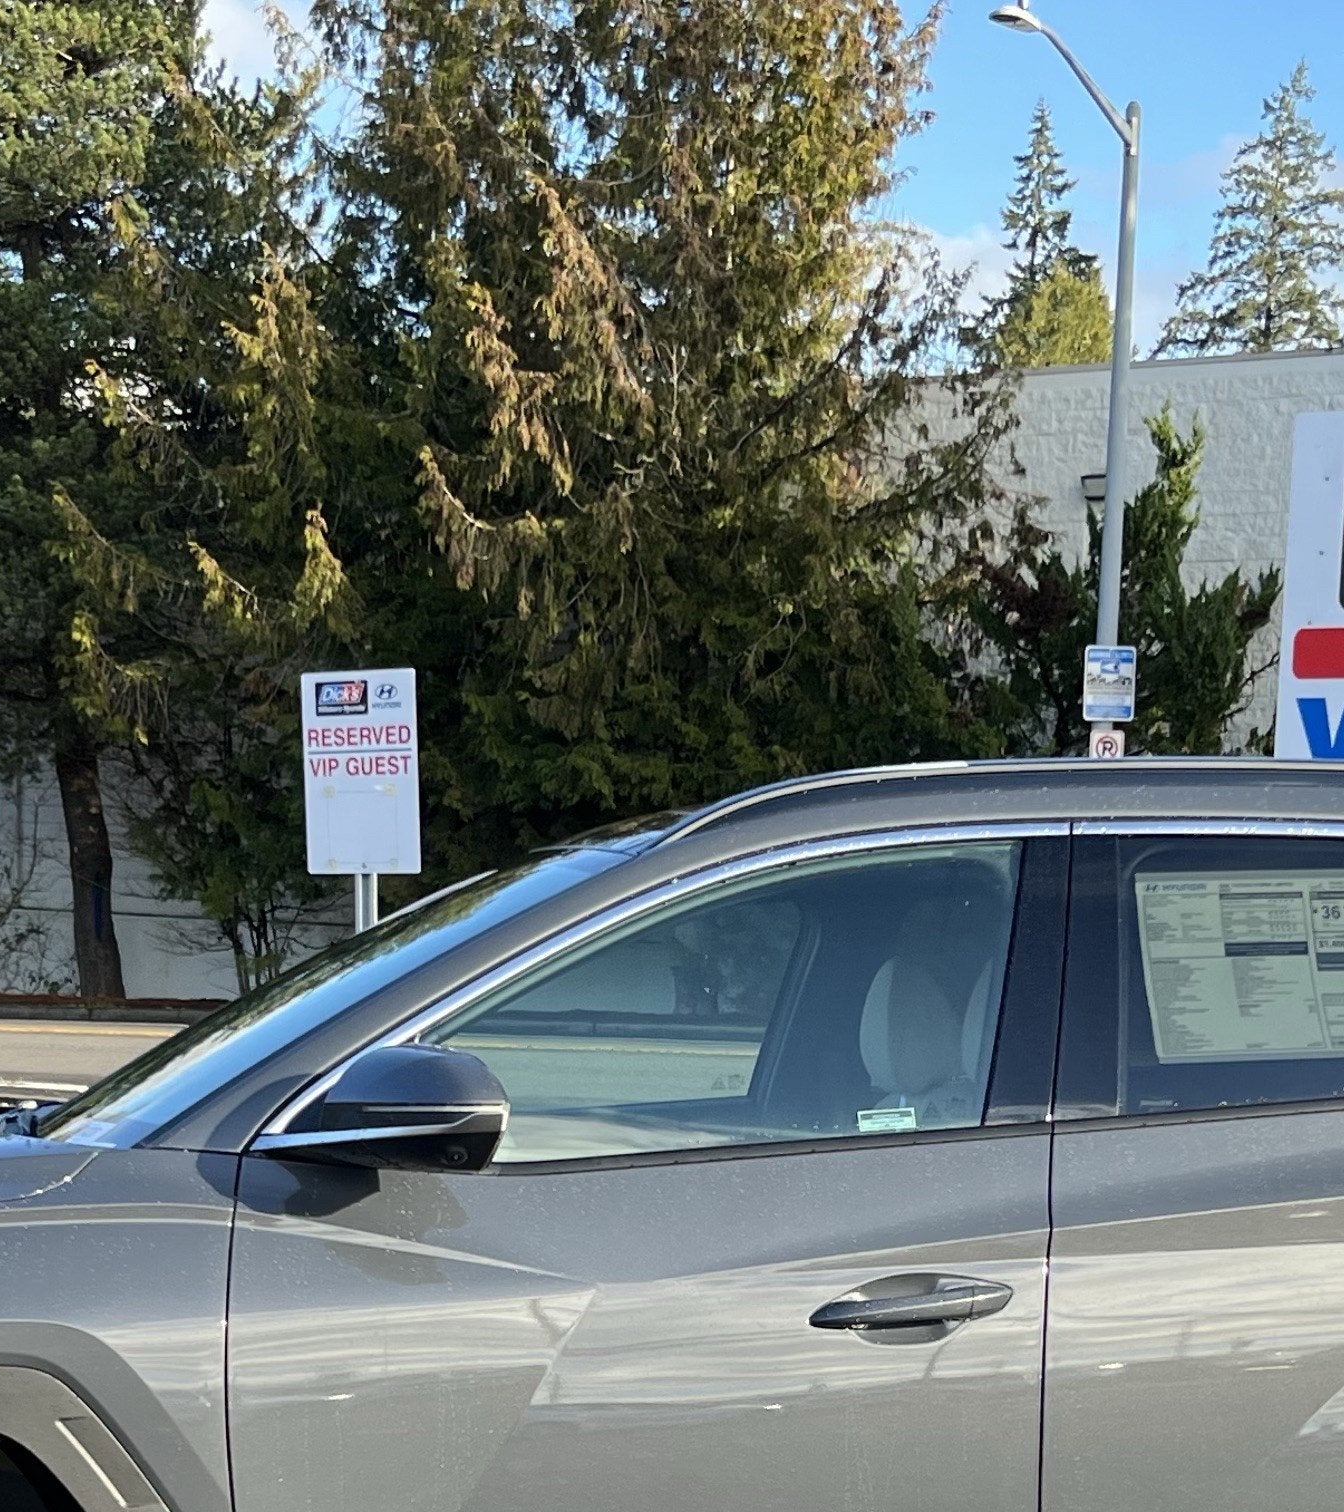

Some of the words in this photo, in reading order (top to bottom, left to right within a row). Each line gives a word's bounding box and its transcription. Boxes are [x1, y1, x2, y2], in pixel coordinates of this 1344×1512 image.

[307, 725, 411, 748] RESERVED
[309, 757, 339, 777] VIP
[346, 755, 412, 776] GUEST
[1321, 905, 1341, 920] 36
